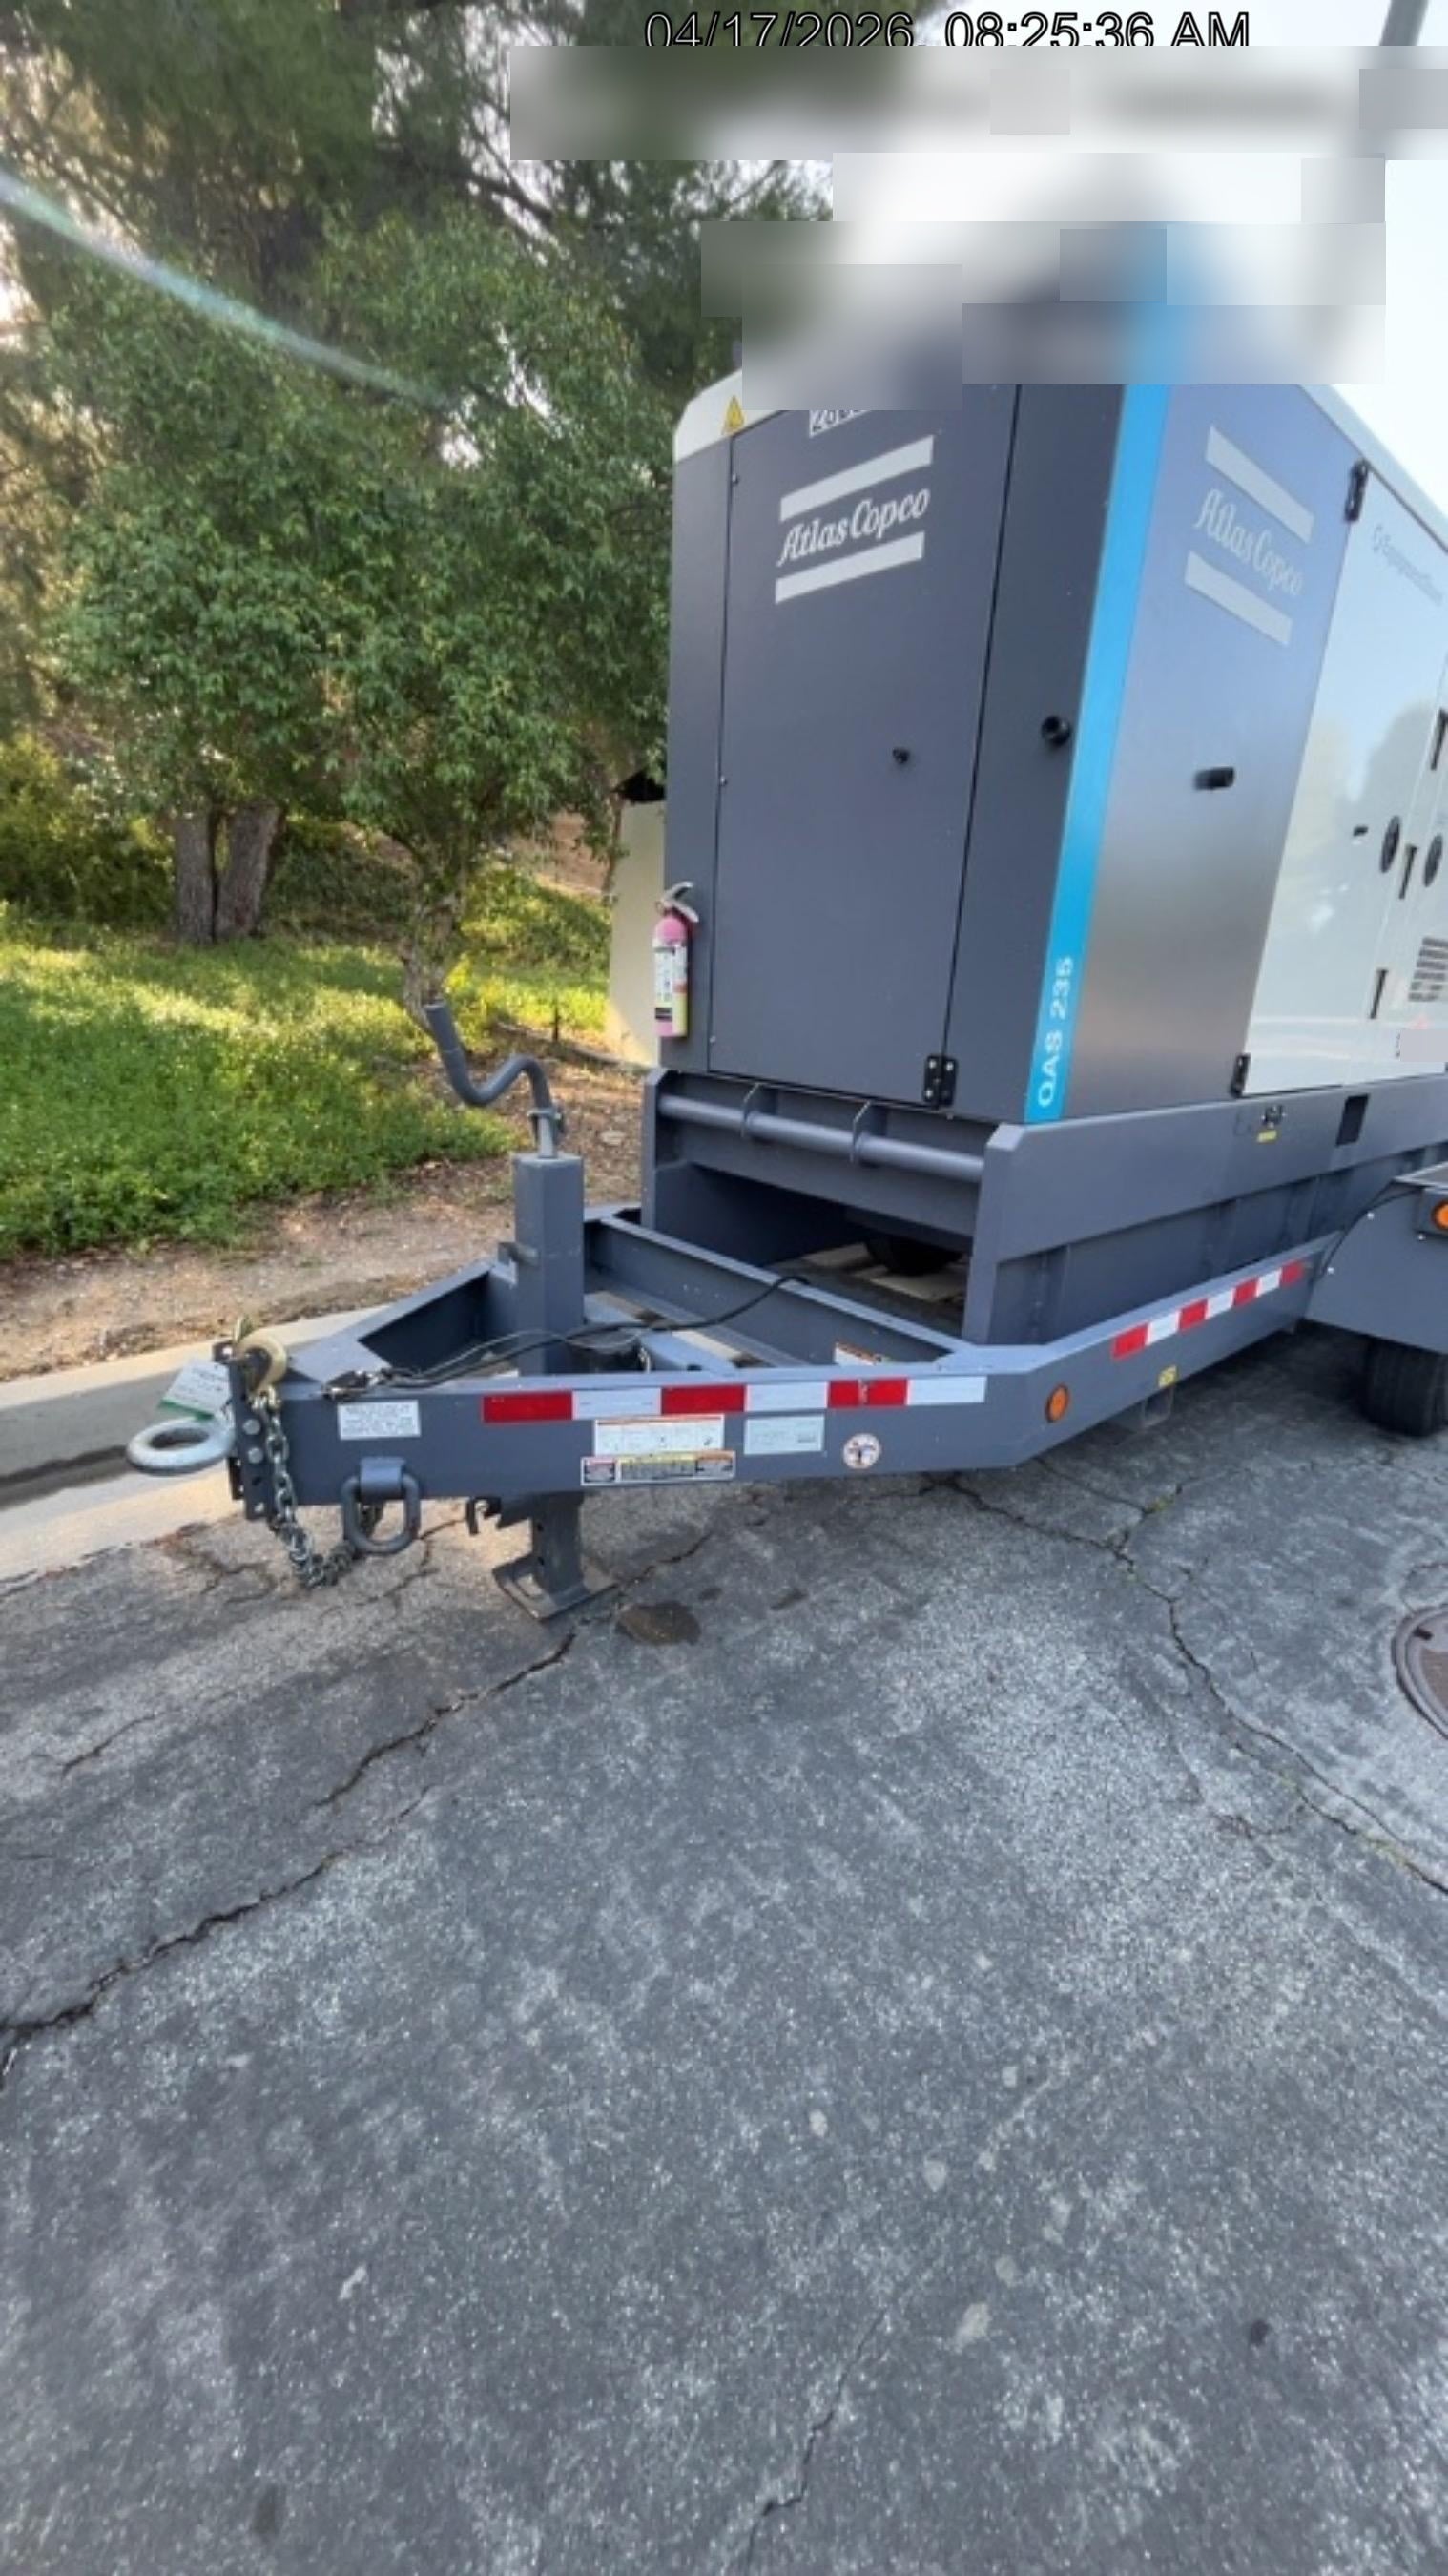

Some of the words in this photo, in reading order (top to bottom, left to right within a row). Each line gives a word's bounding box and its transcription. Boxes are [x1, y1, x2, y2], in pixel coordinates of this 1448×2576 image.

[776, 517, 847, 567] Atlas
[852, 488, 930, 540] Copco
[1193, 488, 1253, 563] Atlas
[1252, 530, 1304, 596] Copco
[1037, 1029, 1063, 1107] QAS
[1050, 957, 1073, 1020] 235
